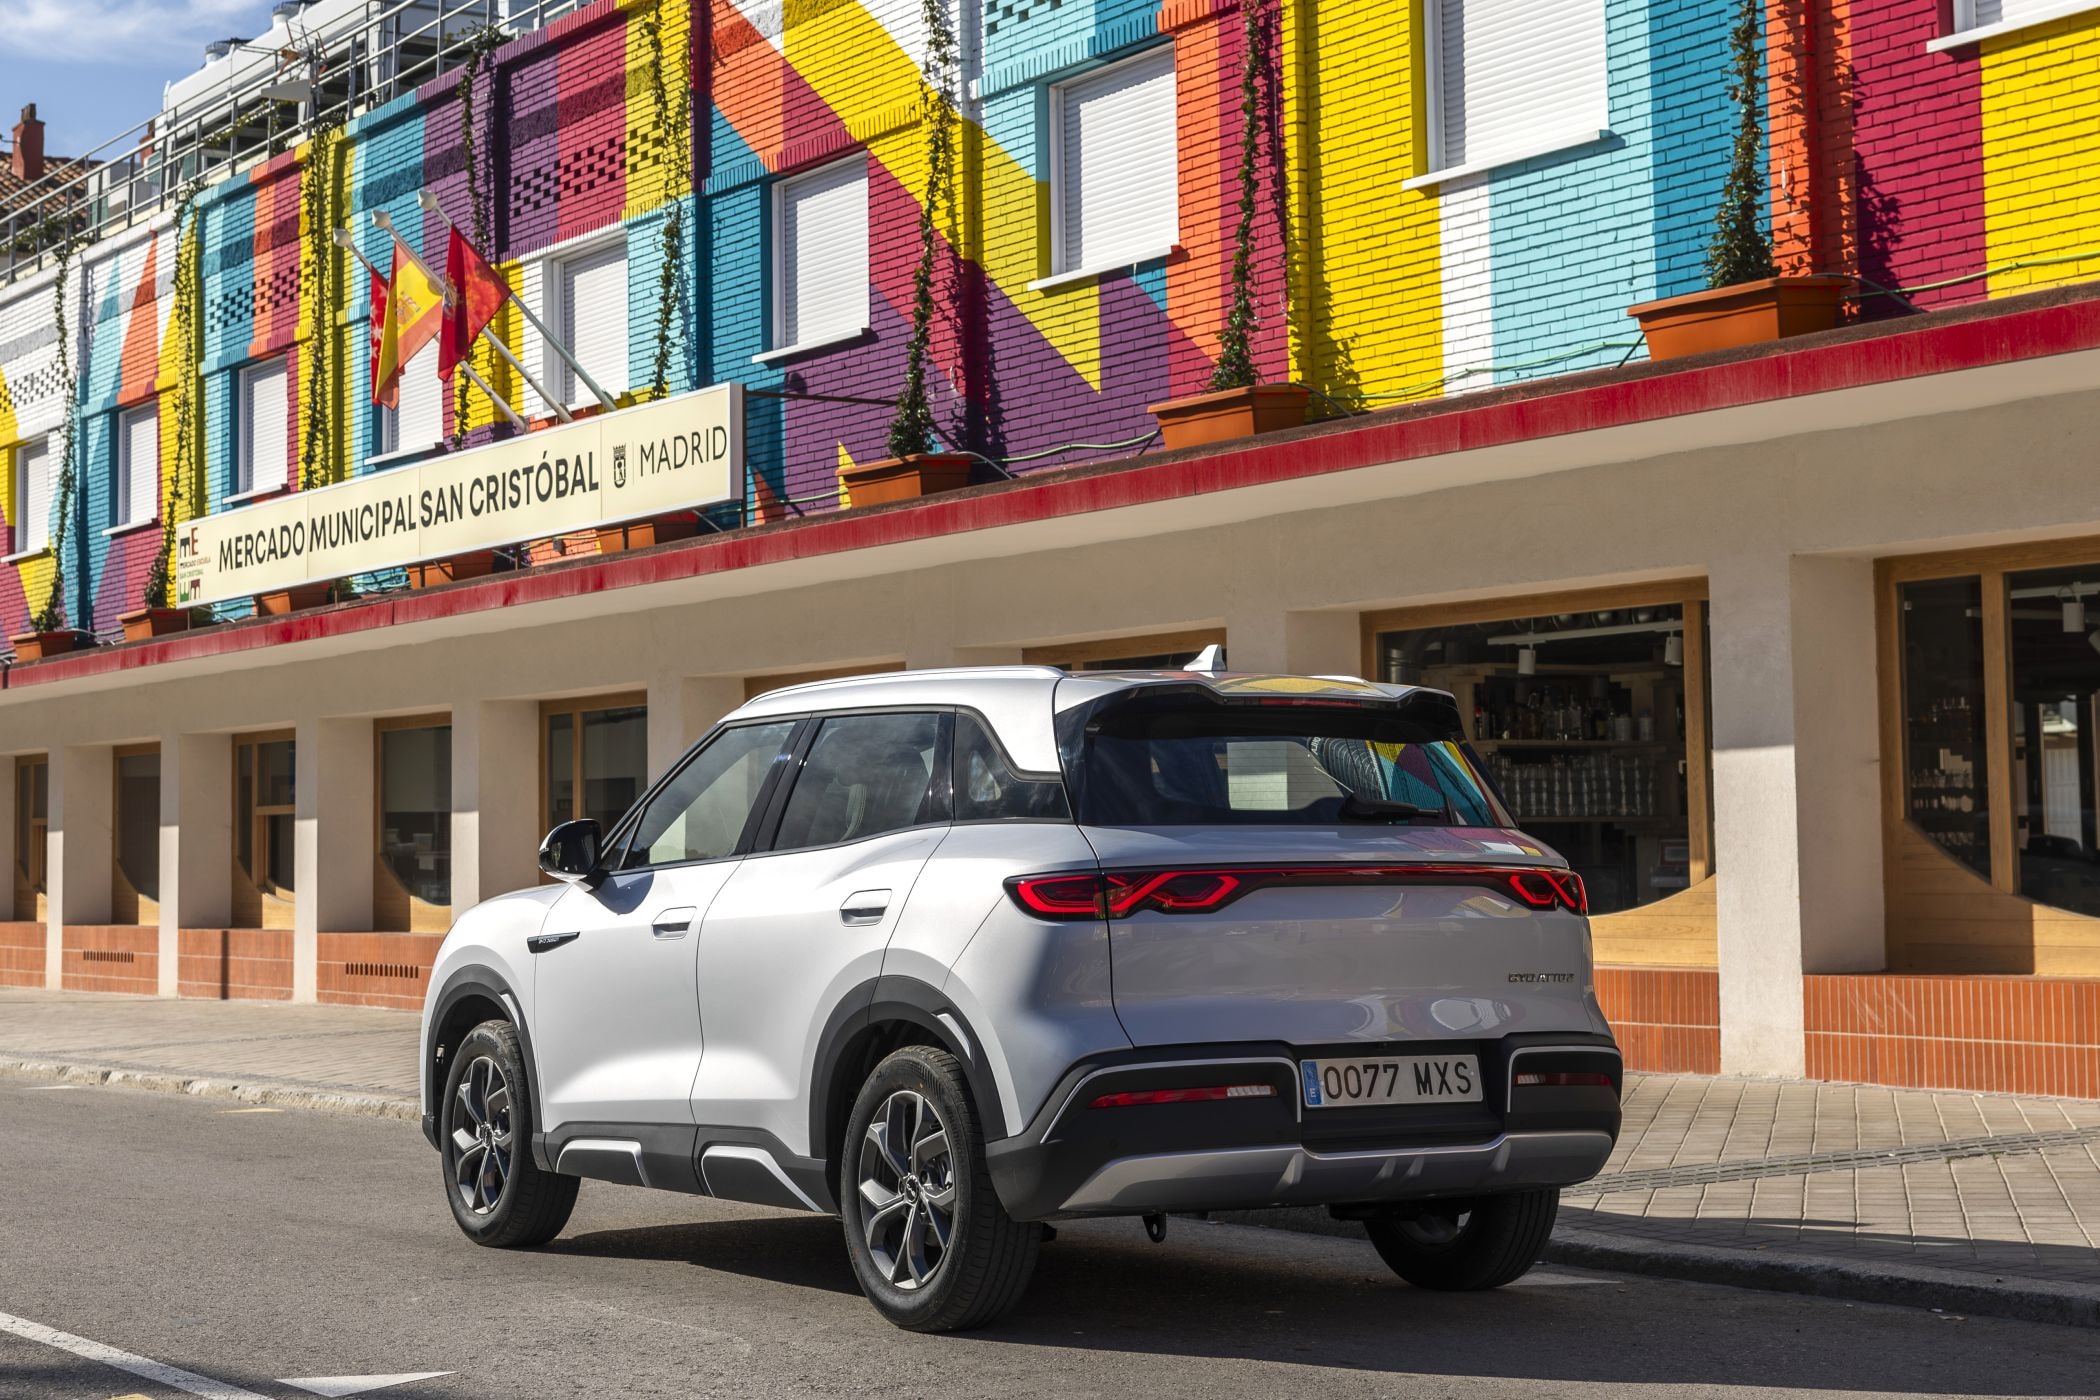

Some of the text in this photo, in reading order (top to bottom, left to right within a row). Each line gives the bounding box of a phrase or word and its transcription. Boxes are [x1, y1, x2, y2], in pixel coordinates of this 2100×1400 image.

[640, 425, 727, 477] MADRID
[218, 450, 600, 573] MERCADO MUNICIPAL SAN CRISTÓBAL
[1309, 1087, 1317, 1098] E
[1323, 1061, 1472, 1100] 0077 MXS
